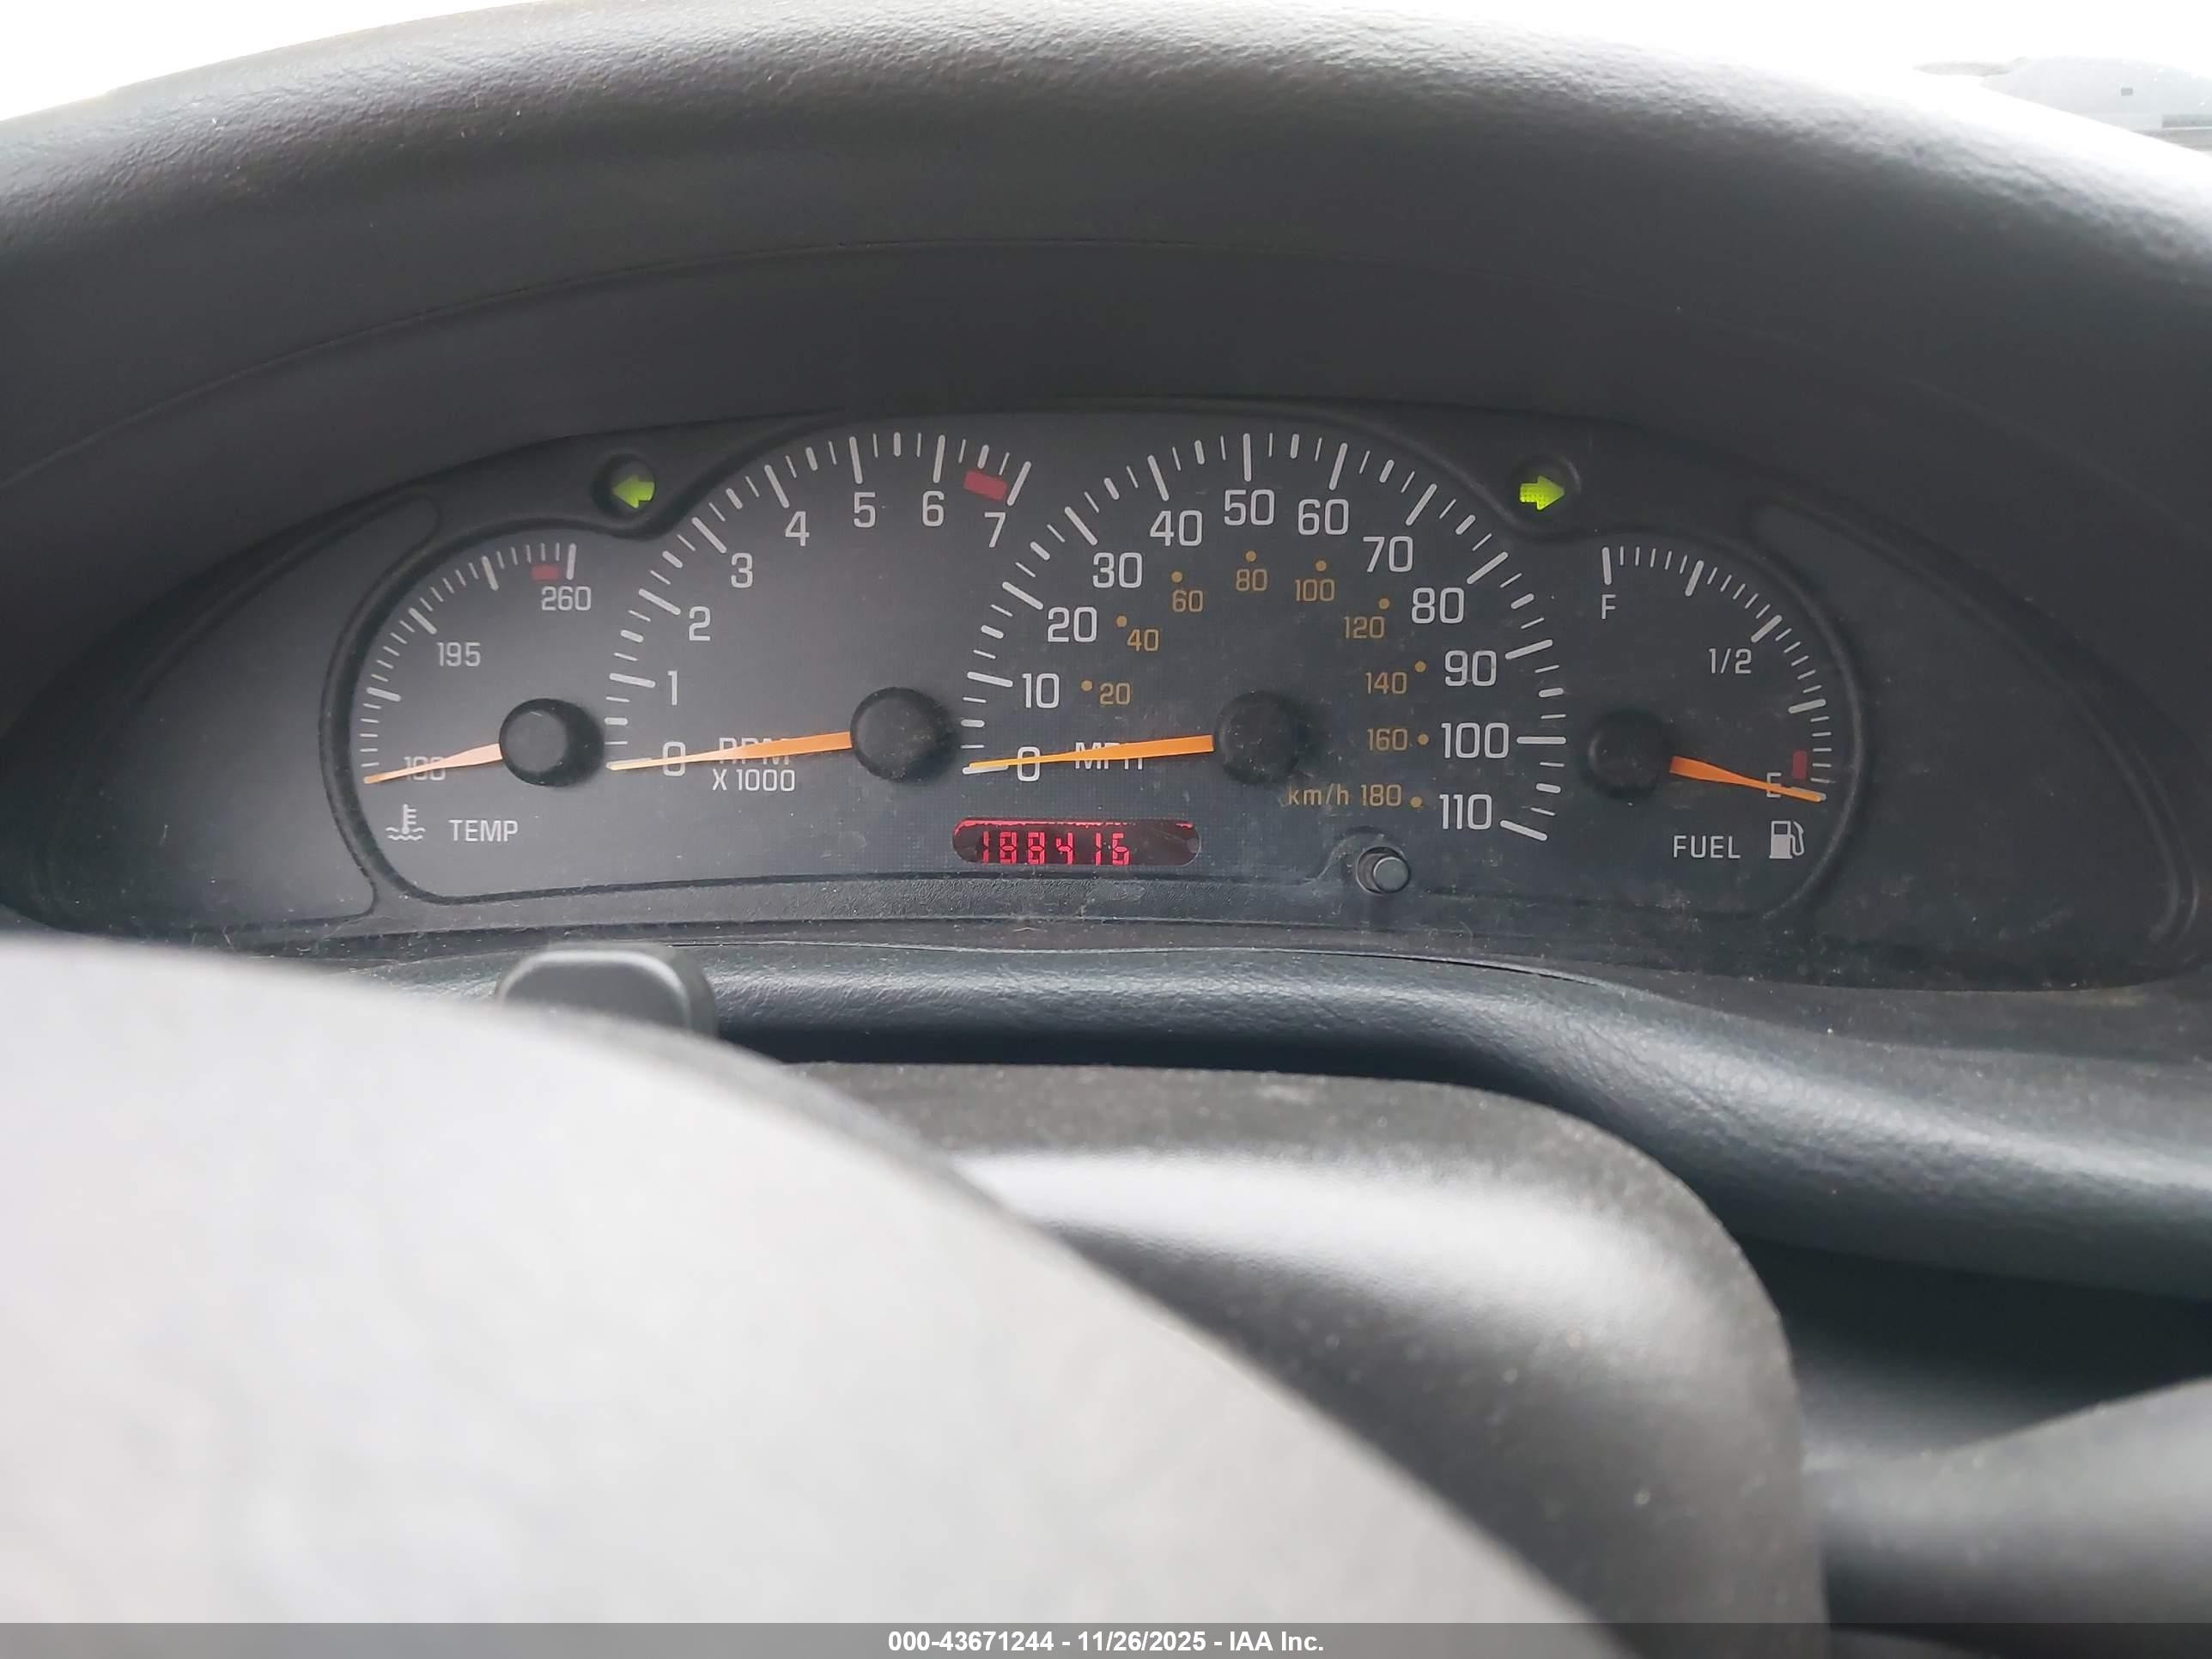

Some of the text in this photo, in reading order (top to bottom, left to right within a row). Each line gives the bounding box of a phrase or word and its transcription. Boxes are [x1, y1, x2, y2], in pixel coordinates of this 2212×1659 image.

[854, 491, 876, 528] 5
[922, 490, 945, 527] 6
[1224, 489, 1275, 526] 50
[1297, 498, 1349, 536] 60
[785, 511, 810, 547] 4
[984, 512, 1006, 548] 7
[1150, 509, 1203, 547] 40
[731, 552, 753, 588] 3
[1092, 552, 1143, 588] 30
[1363, 536, 1413, 573] 70
[1236, 568, 1267, 592] 80
[1295, 578, 1335, 602] 100
[541, 586, 592, 611] 260
[1172, 589, 1204, 612] 60
[1411, 586, 1465, 624] 80
[1601, 593, 1616, 620] F
[689, 605, 711, 641] 2
[1048, 606, 1097, 642] 20
[1127, 629, 1159, 652] 40
[1344, 616, 1385, 639] 120
[437, 641, 481, 667] 195
[1444, 650, 1497, 687] 90
[1709, 647, 1752, 674] 1/2
[667, 670, 678, 706] 1
[1022, 672, 1060, 708] 10
[1099, 683, 1131, 705] 20
[1365, 672, 1407, 695] 140
[1367, 728, 1408, 751] 160
[1441, 722, 1510, 759] 100
[662, 741, 686, 777] 0
[1017, 746, 1041, 782] 0
[712, 769, 795, 792] X 1000
[1288, 783, 1349, 805] km/h
[1360, 784, 1402, 806] 180
[1439, 793, 1492, 830] 110
[448, 819, 518, 842] TEMP
[982, 830, 1131, 866] 188416
[1673, 835, 1741, 859] FUEL
